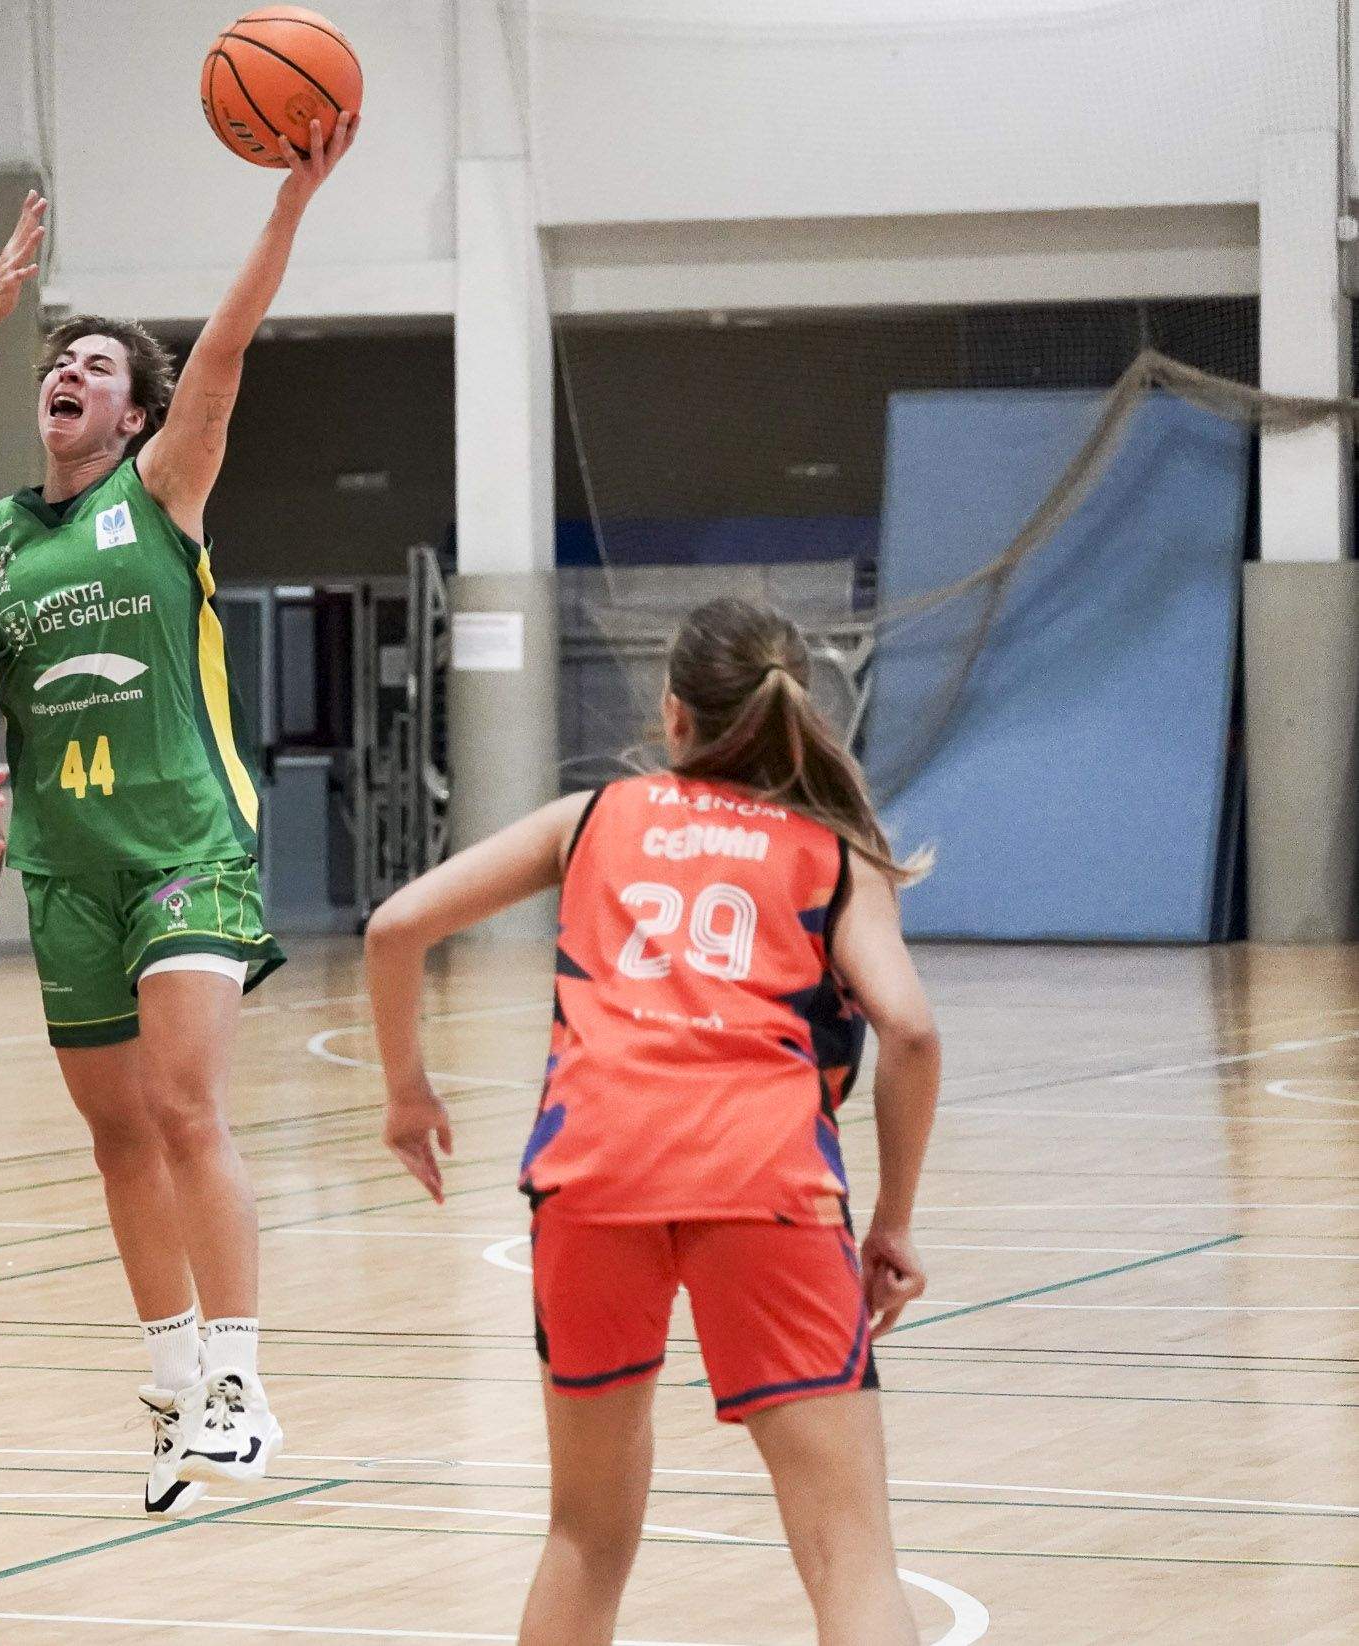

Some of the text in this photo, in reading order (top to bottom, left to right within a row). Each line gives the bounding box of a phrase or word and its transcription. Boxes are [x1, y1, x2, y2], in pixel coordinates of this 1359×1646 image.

[33, 581, 105, 618] XUNTA
[38, 594, 151, 634] DE GALICIA
[60, 735, 115, 799] 44
[618, 881, 758, 981] 29
